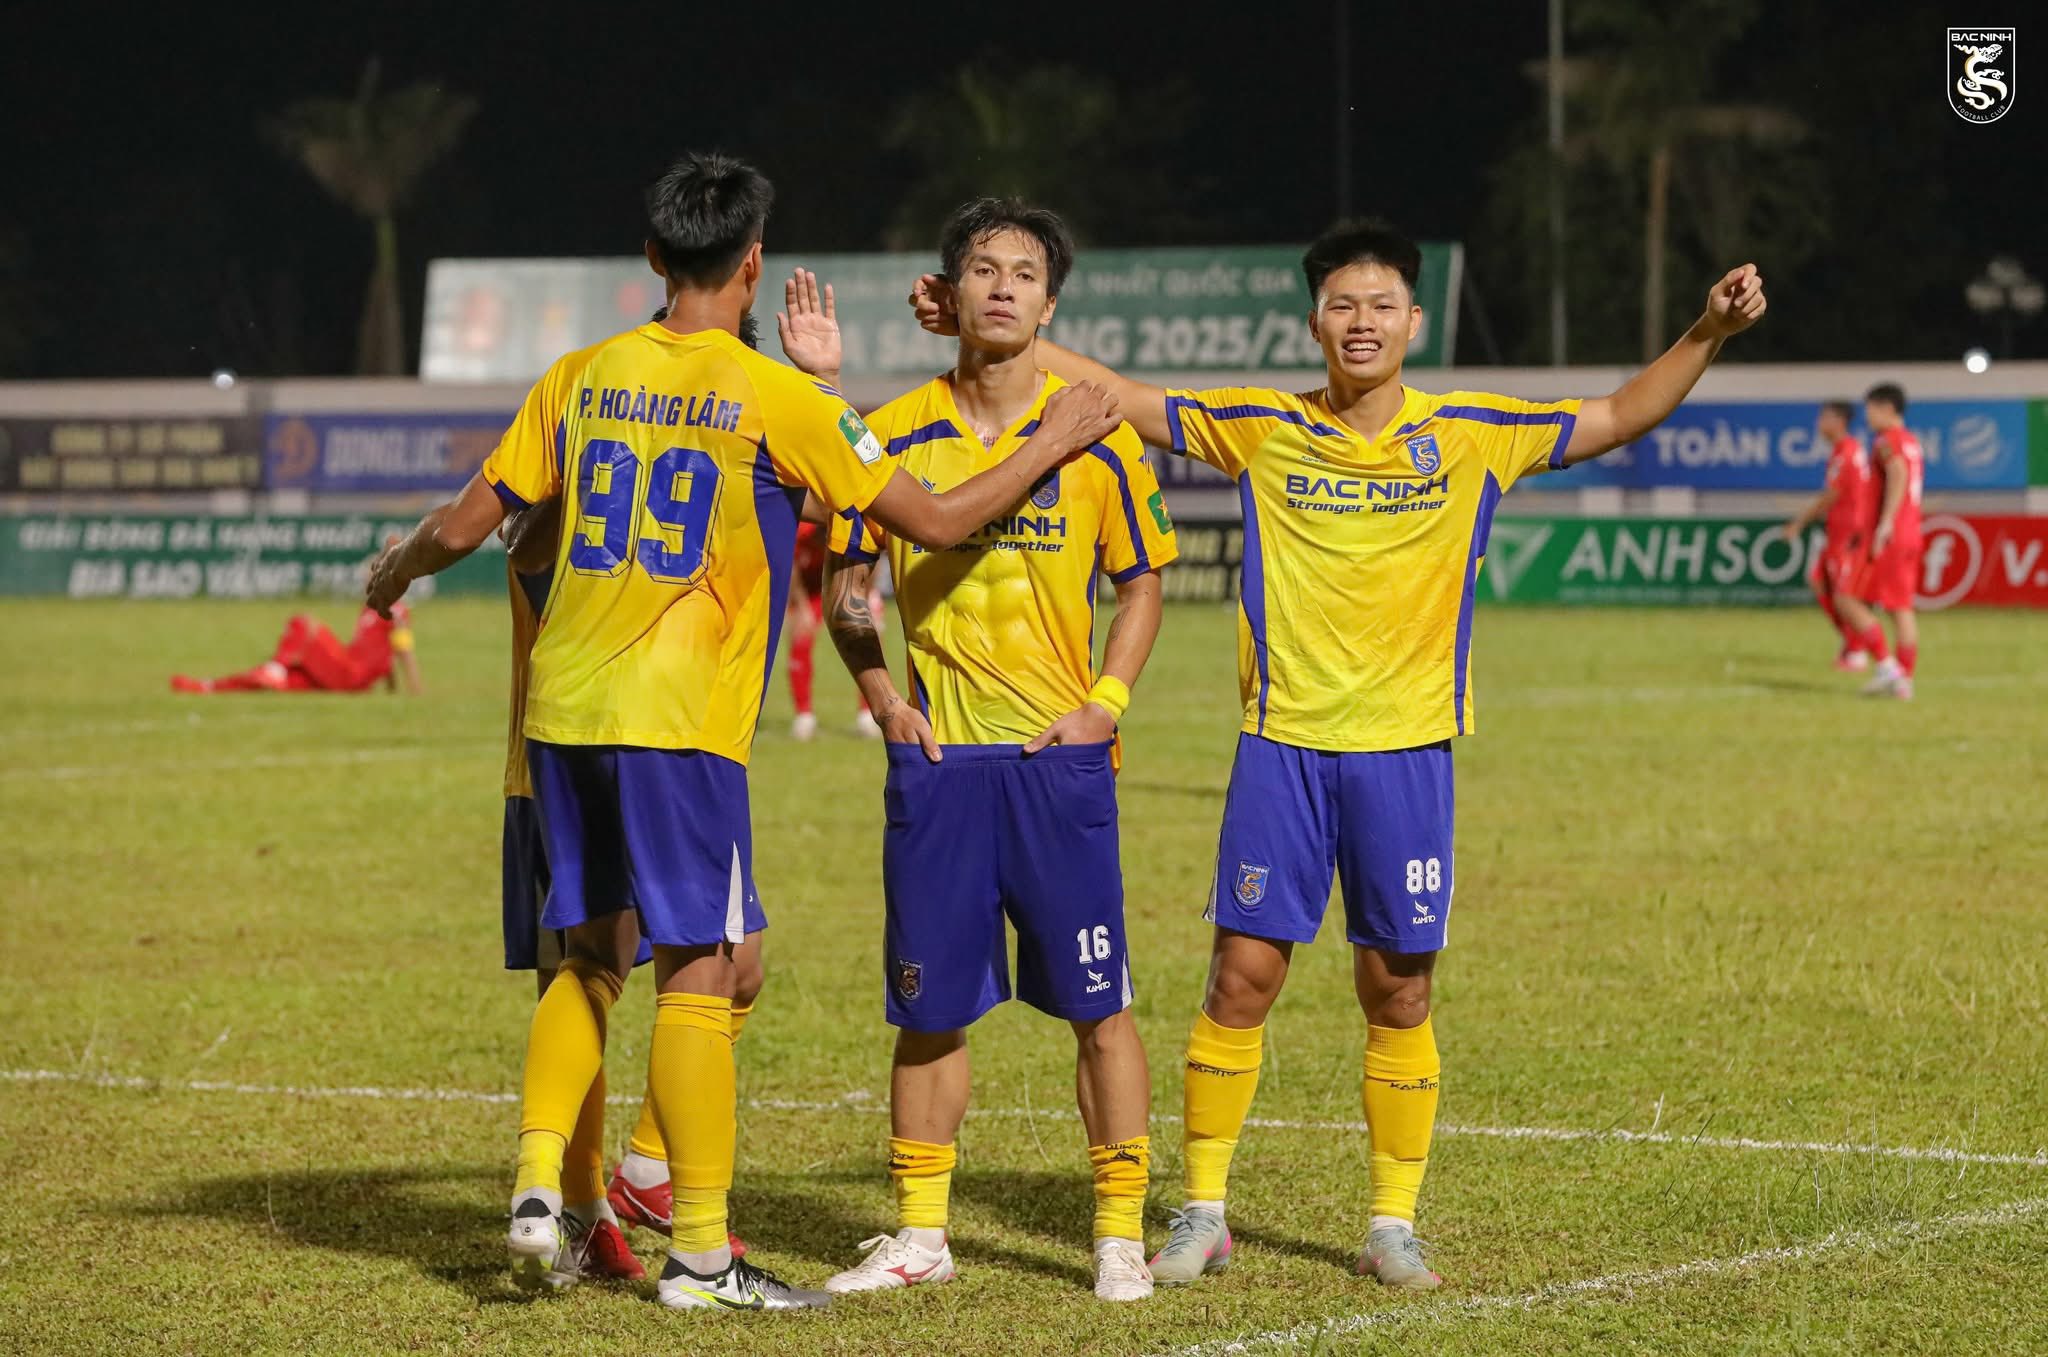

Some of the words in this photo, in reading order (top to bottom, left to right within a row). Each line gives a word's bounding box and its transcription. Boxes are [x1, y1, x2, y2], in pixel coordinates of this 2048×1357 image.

[579, 387, 593, 419] P.
[599, 385, 683, 426] HOÀNG
[685, 391, 743, 433] LÂM
[1655, 418, 1770, 468] TOÀN
[1286, 473, 1361, 499] BAC
[1366, 474, 1449, 500] NINH
[1286, 497, 1365, 515] Stronger
[1371, 499, 1446, 515] Together
[569, 438, 724, 585] 99
[1406, 857, 1441, 895] 88
[1077, 925, 1111, 964] 16
